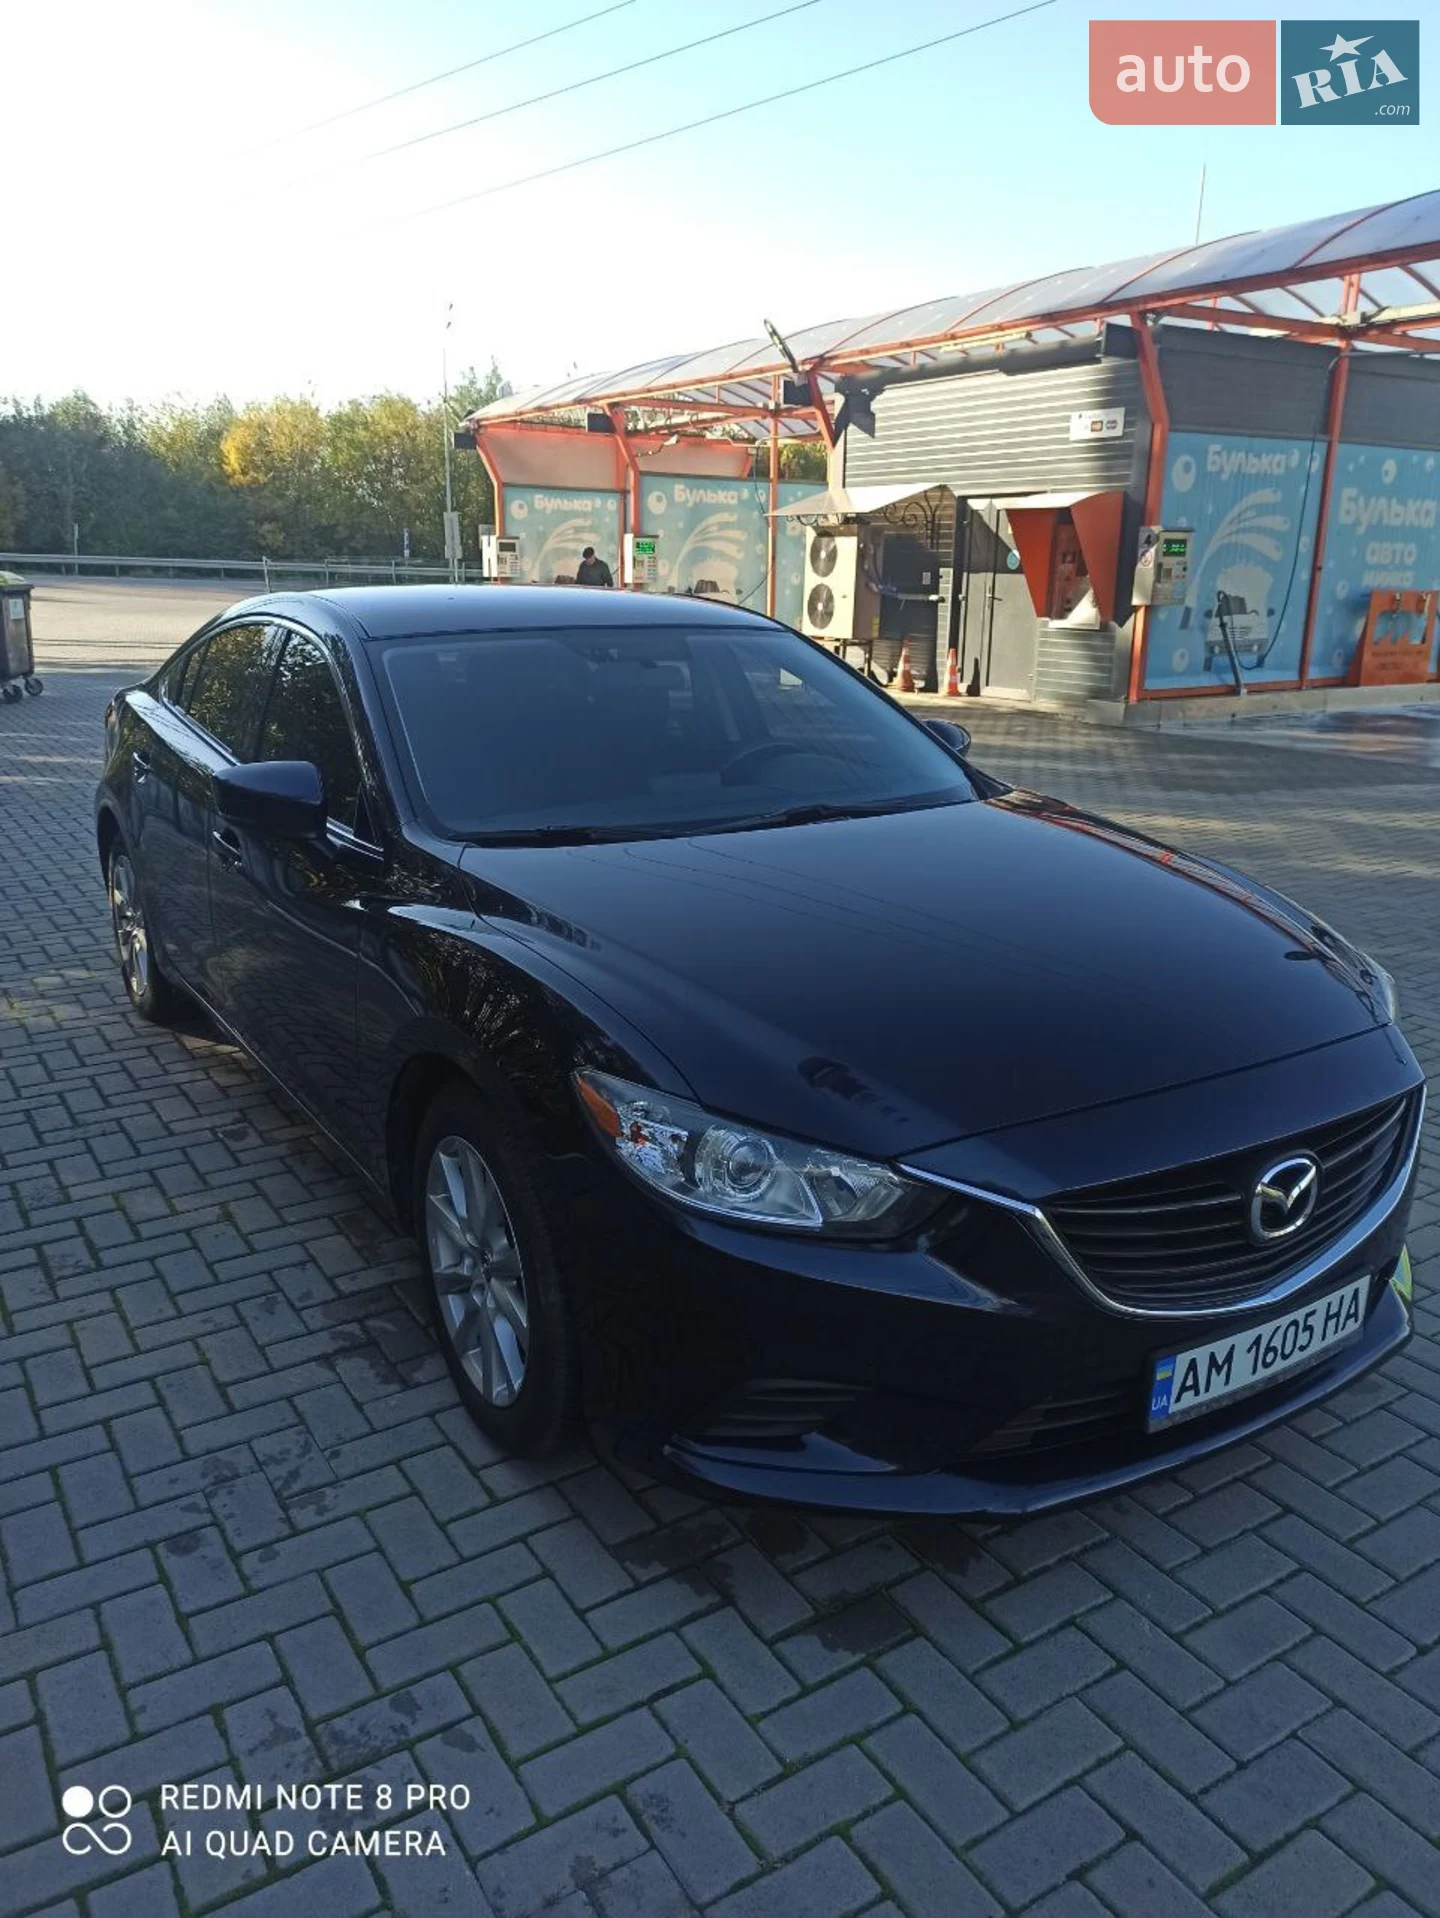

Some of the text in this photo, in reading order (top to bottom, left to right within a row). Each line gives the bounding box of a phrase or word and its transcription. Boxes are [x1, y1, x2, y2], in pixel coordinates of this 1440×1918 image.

[1207, 443, 1287, 480] Булька
[533, 493, 592, 514] Булька
[673, 483, 738, 507] Булька
[1338, 487, 1437, 535] Булька
[1366, 541, 1416, 566] авто
[1174, 1286, 1361, 1404] AM 1605 HA
[1152, 1396, 1169, 1411] UA
